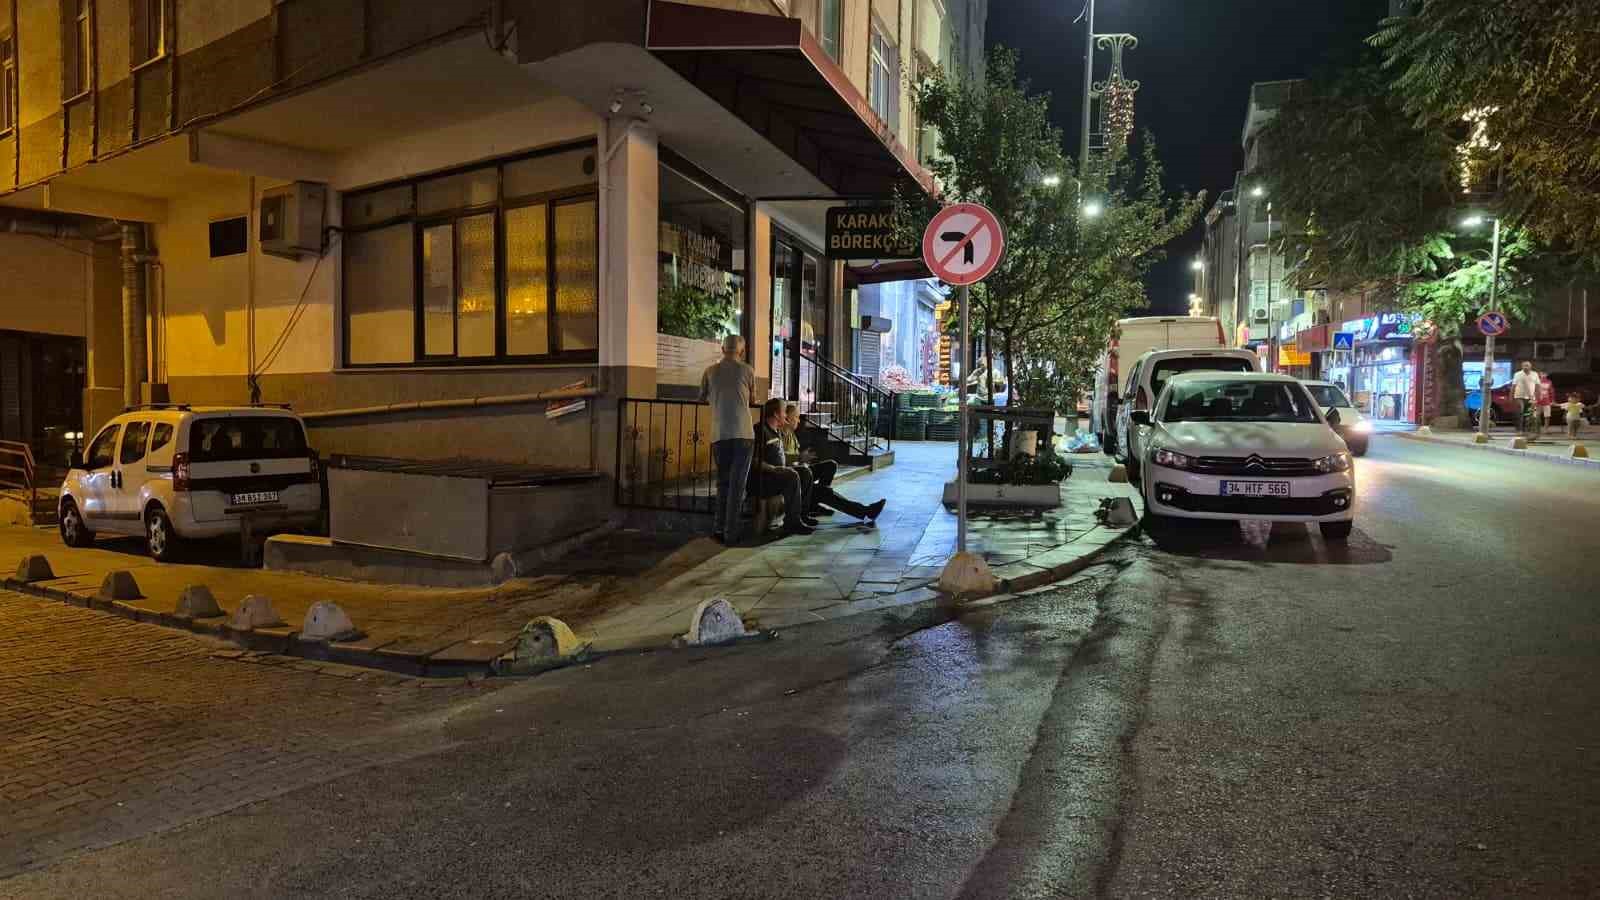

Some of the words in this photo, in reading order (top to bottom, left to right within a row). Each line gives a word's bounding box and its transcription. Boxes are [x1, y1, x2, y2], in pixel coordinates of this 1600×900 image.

[837, 211, 900, 229] KARAK
[831, 230, 914, 253] BÖREKÇ
[1228, 482, 1239, 493] 34
[1244, 482, 1263, 494] HTF
[1268, 483, 1287, 495] 566
